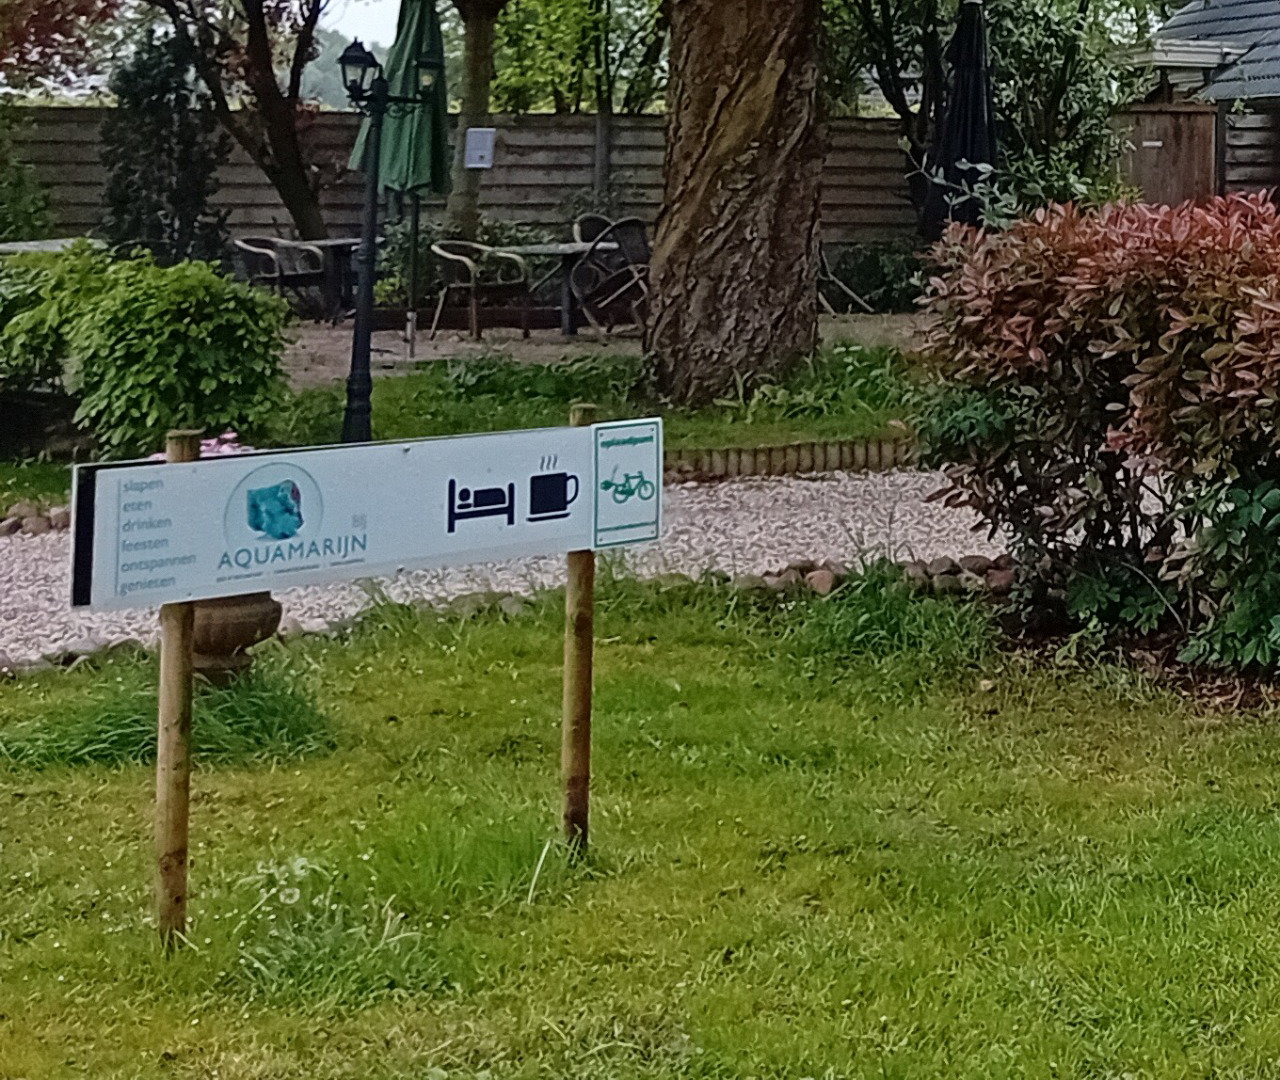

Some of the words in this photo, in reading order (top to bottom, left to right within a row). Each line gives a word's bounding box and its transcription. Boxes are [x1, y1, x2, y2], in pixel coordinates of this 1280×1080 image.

[122, 518, 172, 532] drinken
[217, 533, 368, 570] AQUAMARIJN
[121, 554, 197, 572] ontspannen
